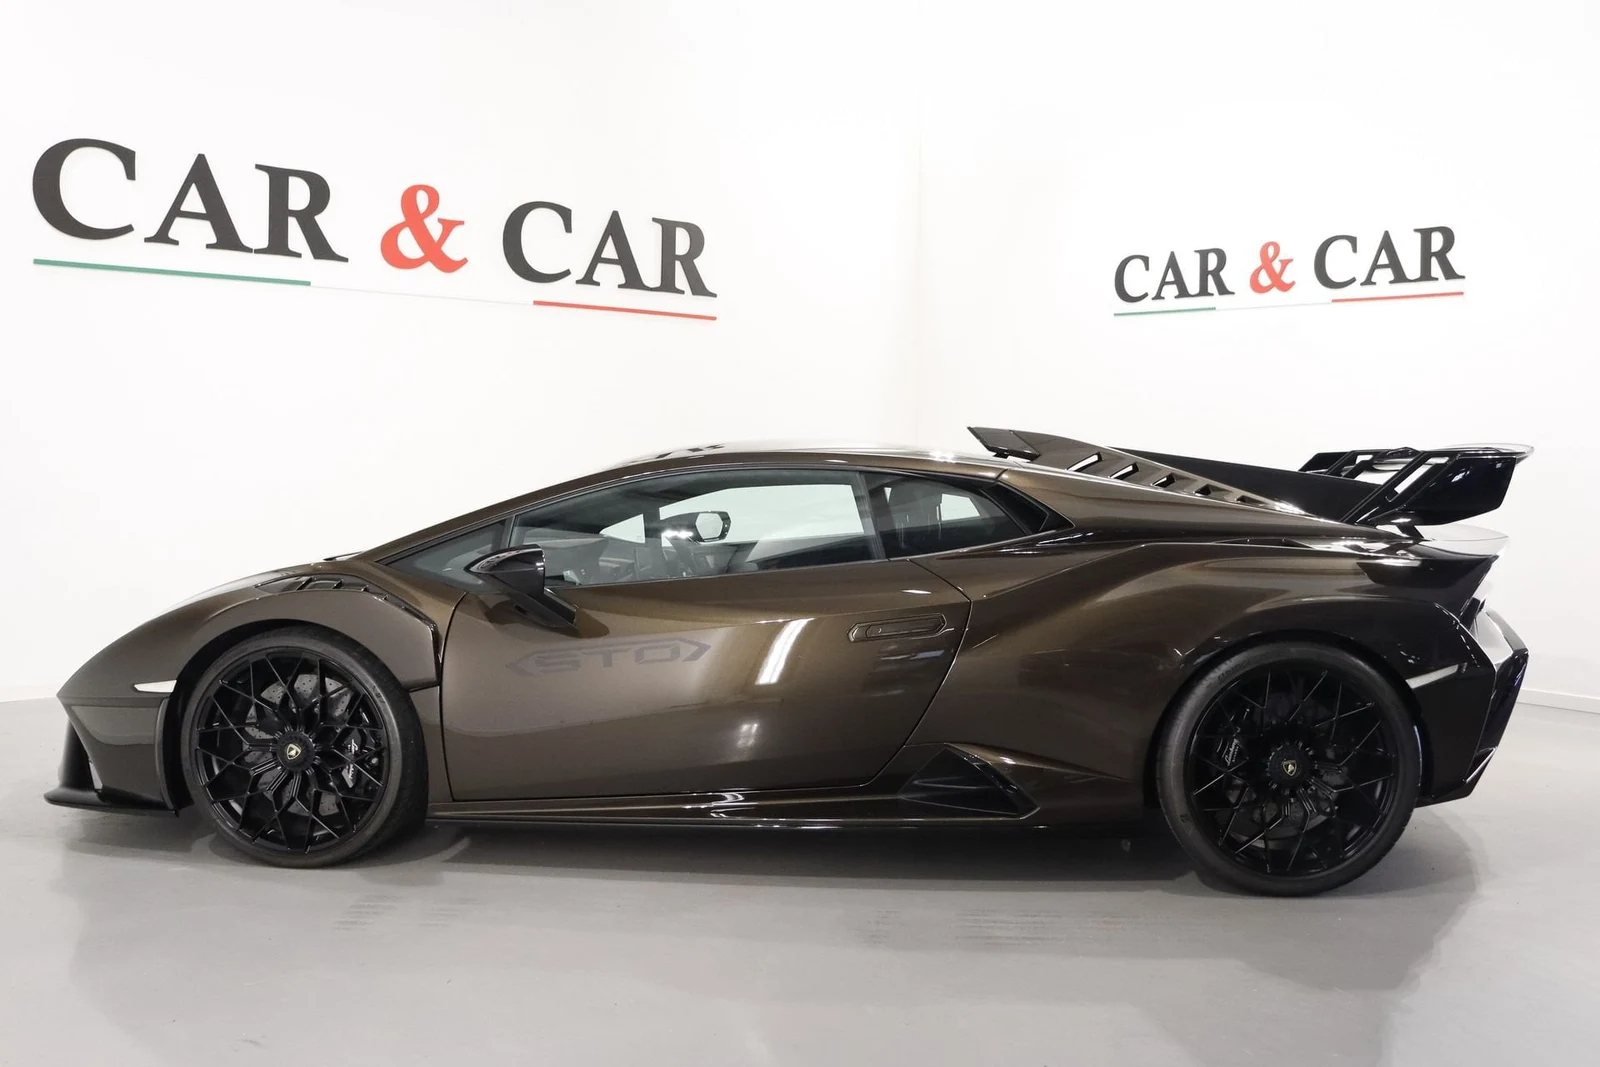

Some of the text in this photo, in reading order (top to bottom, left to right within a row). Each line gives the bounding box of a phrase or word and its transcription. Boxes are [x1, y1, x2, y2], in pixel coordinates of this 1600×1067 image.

[32, 138, 718, 298] CAR & CAR
[1114, 226, 1466, 303] CAR & CAR
[534, 643, 681, 674] STO
